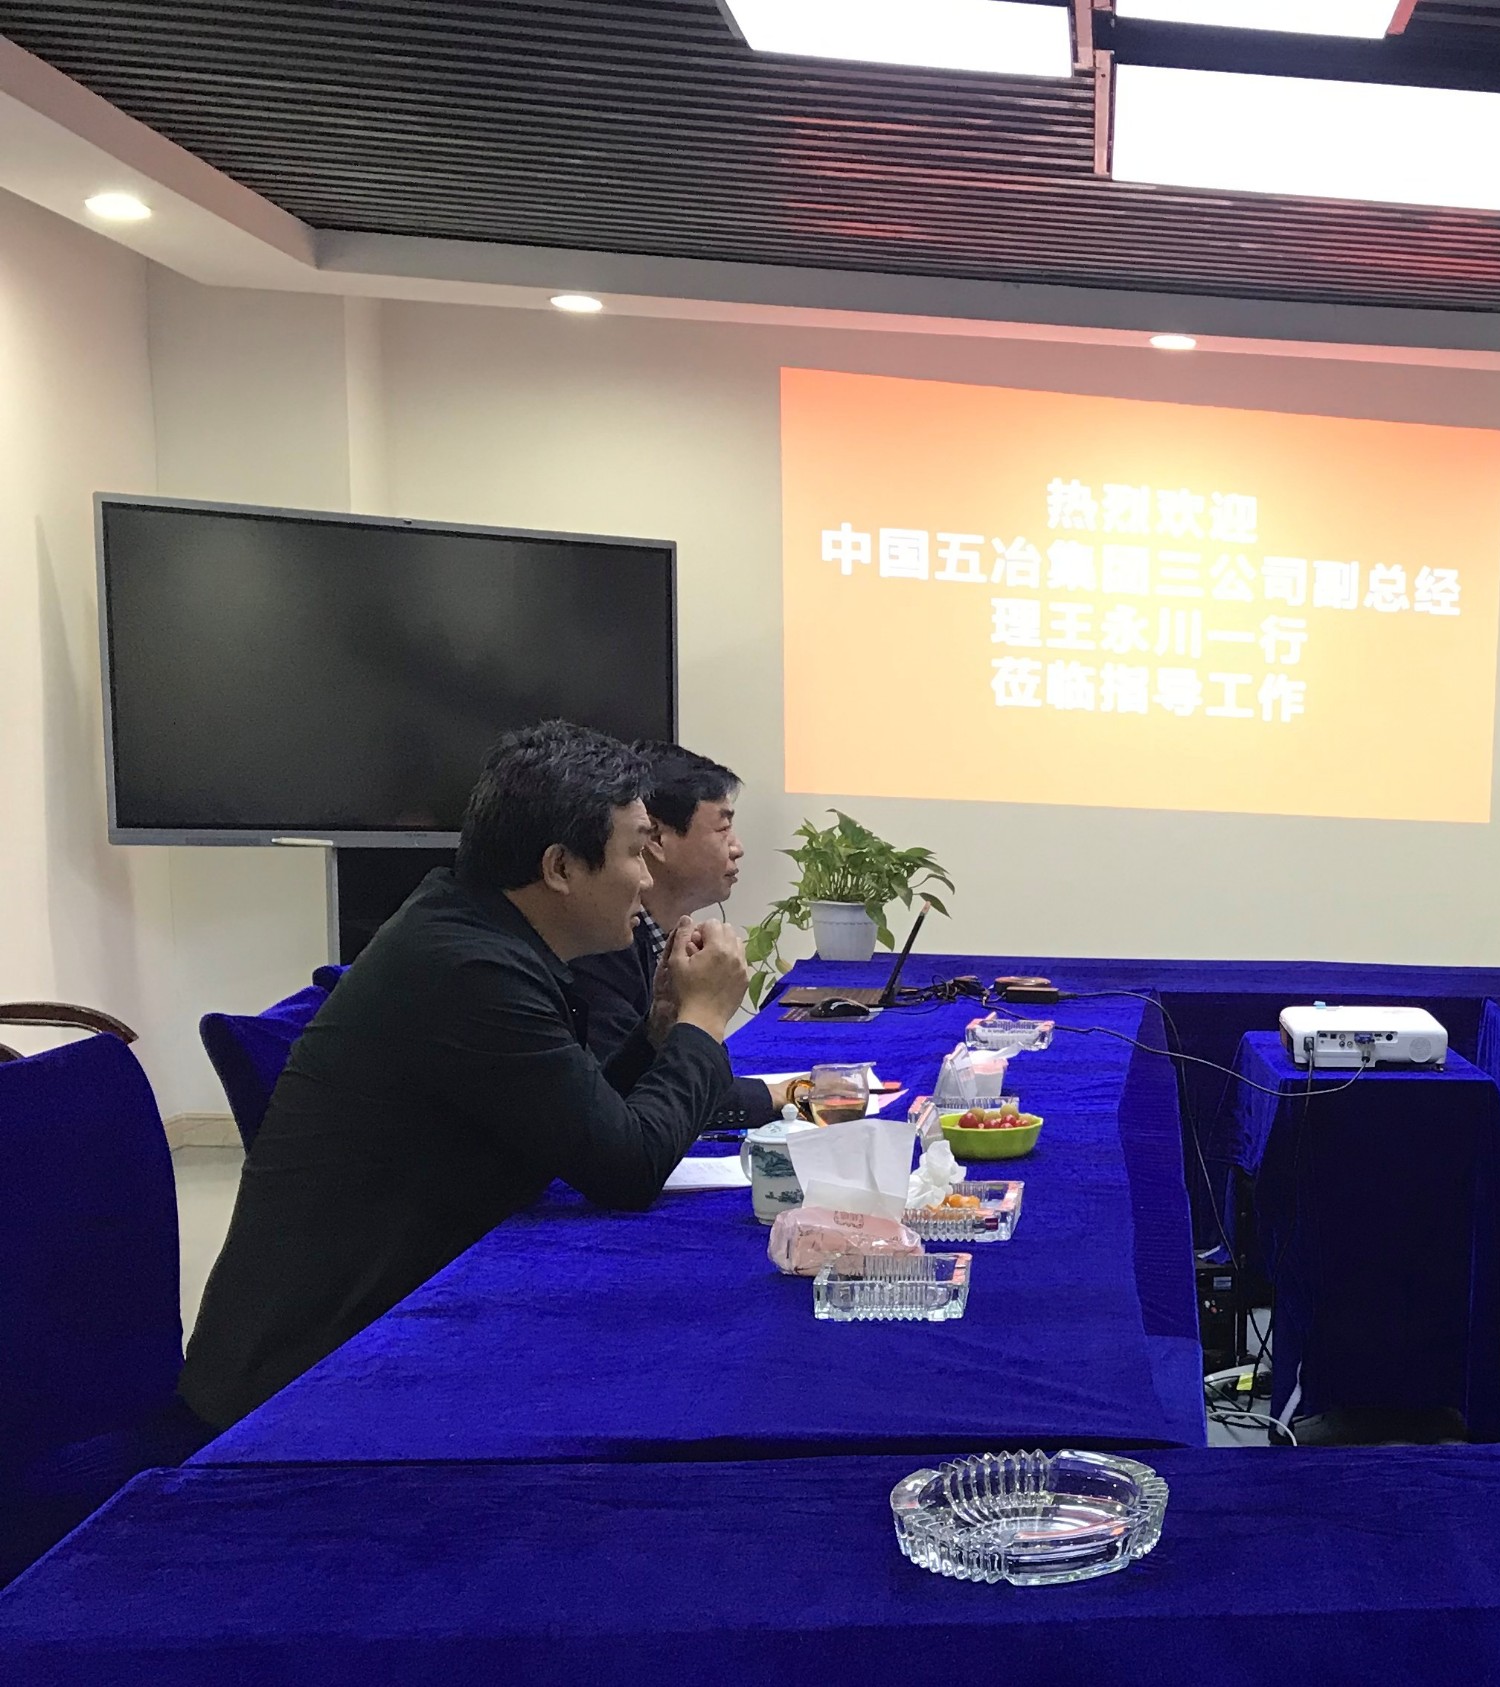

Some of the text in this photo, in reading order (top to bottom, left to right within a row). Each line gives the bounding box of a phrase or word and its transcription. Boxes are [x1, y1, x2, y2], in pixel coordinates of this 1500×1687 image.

[1046, 477, 1258, 545] 热烈欢迎
[821, 522, 1462, 617] 中国五冶集团三公司副总经
[990, 597, 1309, 665] 理王永川一行
[990, 656, 1308, 723] 莅临指导工作
